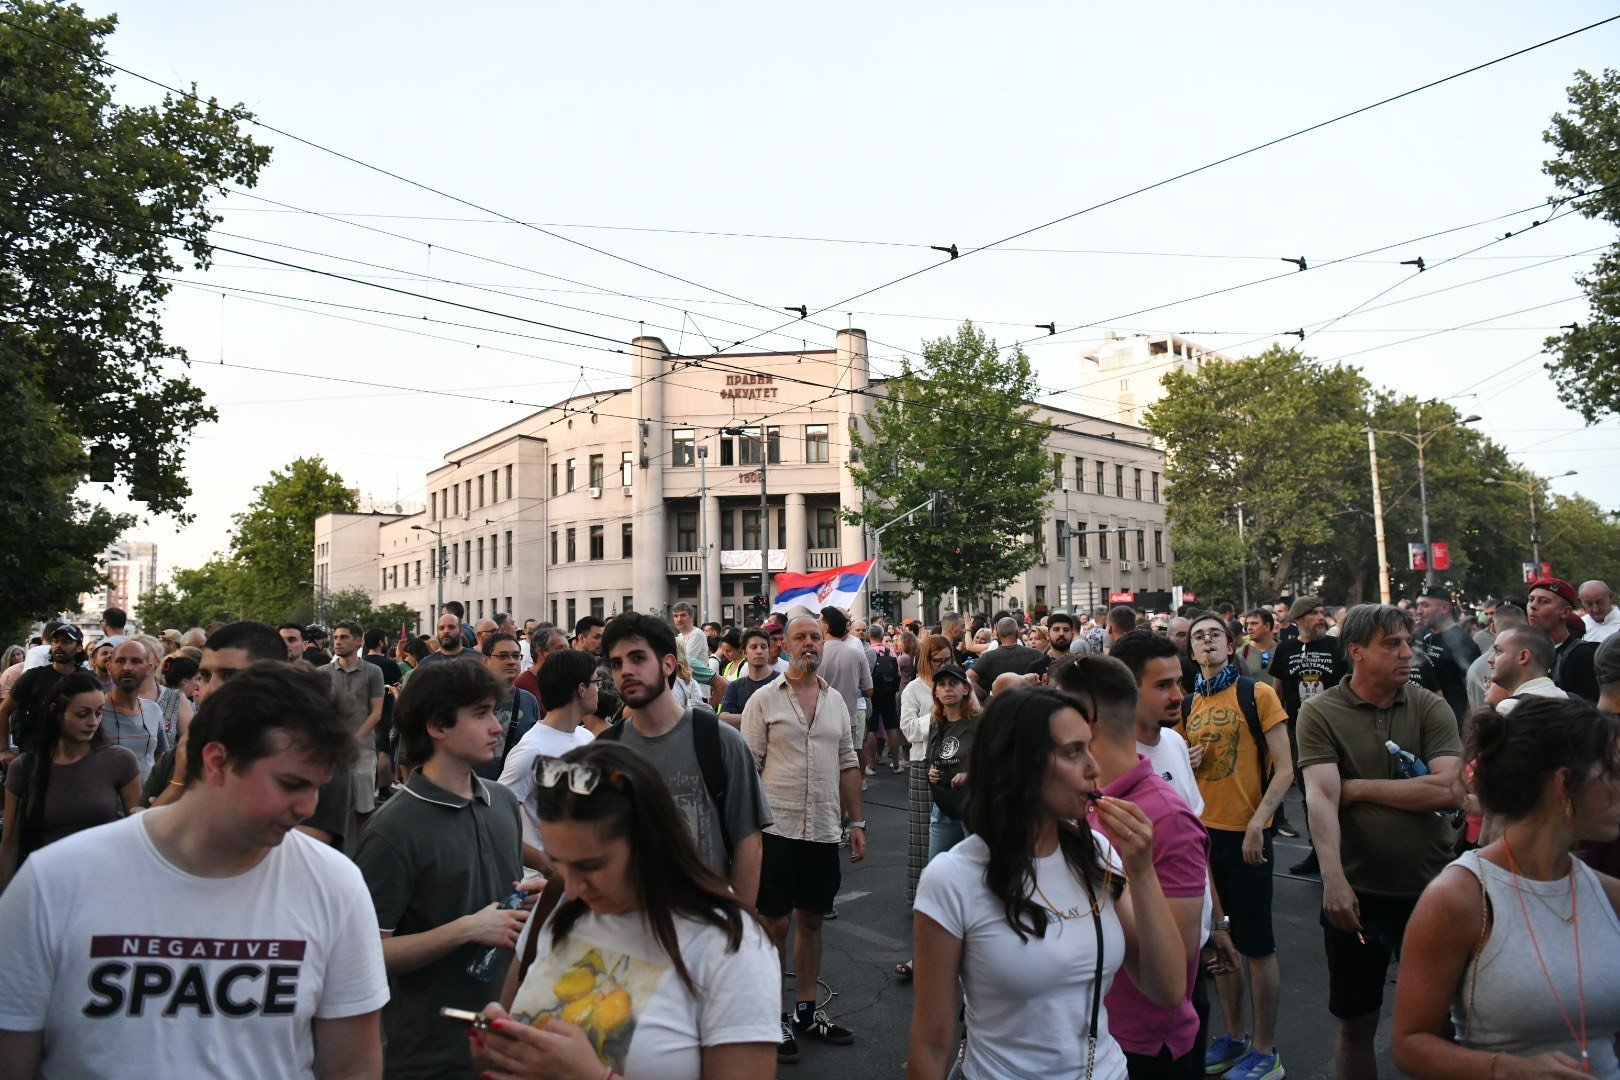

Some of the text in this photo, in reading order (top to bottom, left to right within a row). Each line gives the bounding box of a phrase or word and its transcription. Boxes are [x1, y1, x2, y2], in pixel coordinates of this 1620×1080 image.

[720, 388, 778, 399] ФАКУЛТЕТ
[1301, 662, 1333, 674] ВЕТЕРАНА
[122, 938, 280, 957] NEGATIVE
[81, 960, 301, 1018] SPACE
